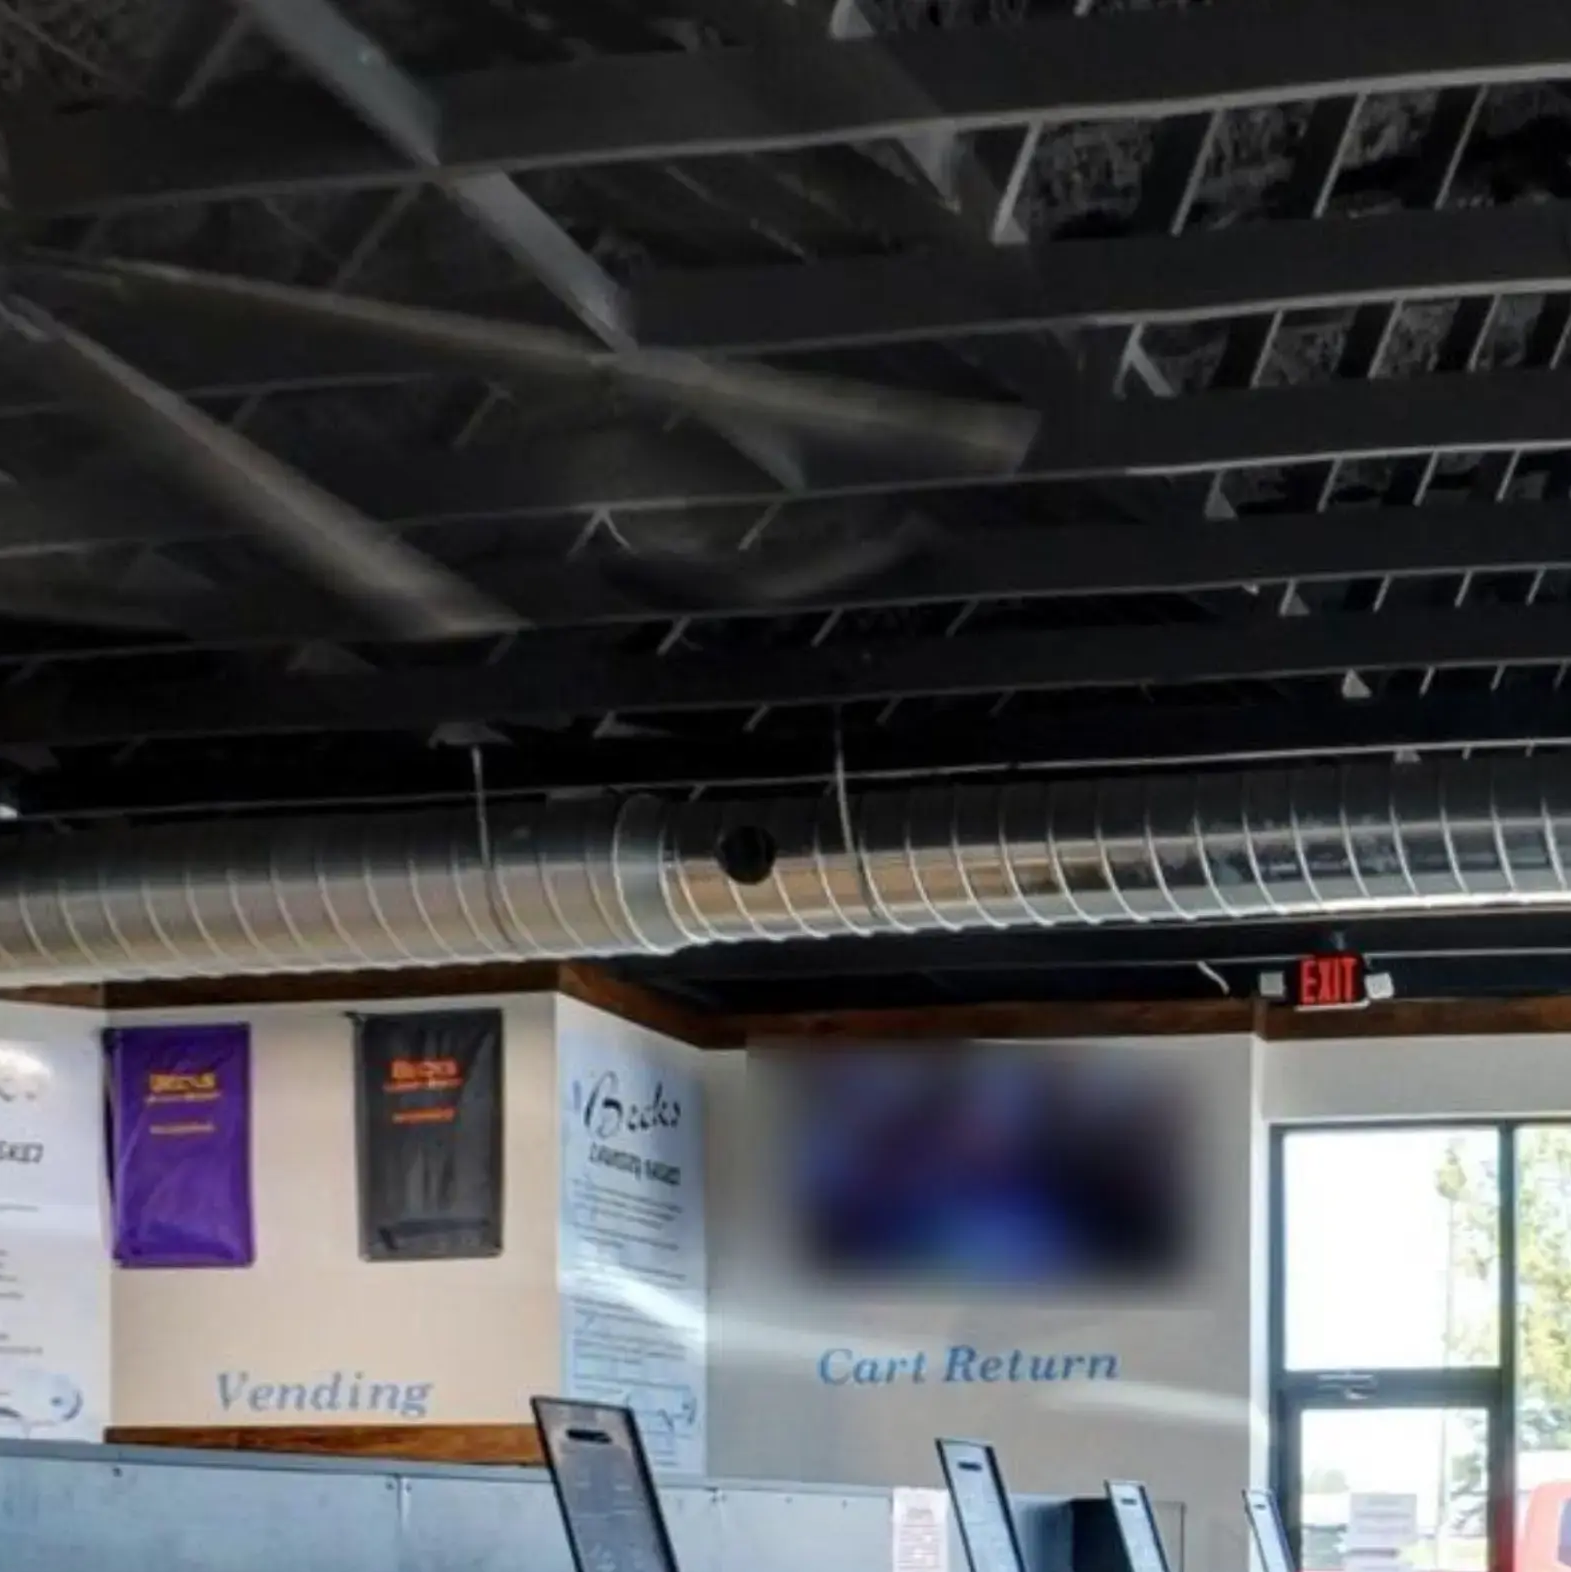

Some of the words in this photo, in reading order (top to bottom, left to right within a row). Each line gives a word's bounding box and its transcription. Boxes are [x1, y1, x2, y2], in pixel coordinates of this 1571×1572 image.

[1302, 957, 1357, 1004] EXIT
[817, 1348, 926, 1386] Cart
[942, 1345, 1119, 1383] Return
[217, 1369, 434, 1418] Vending
